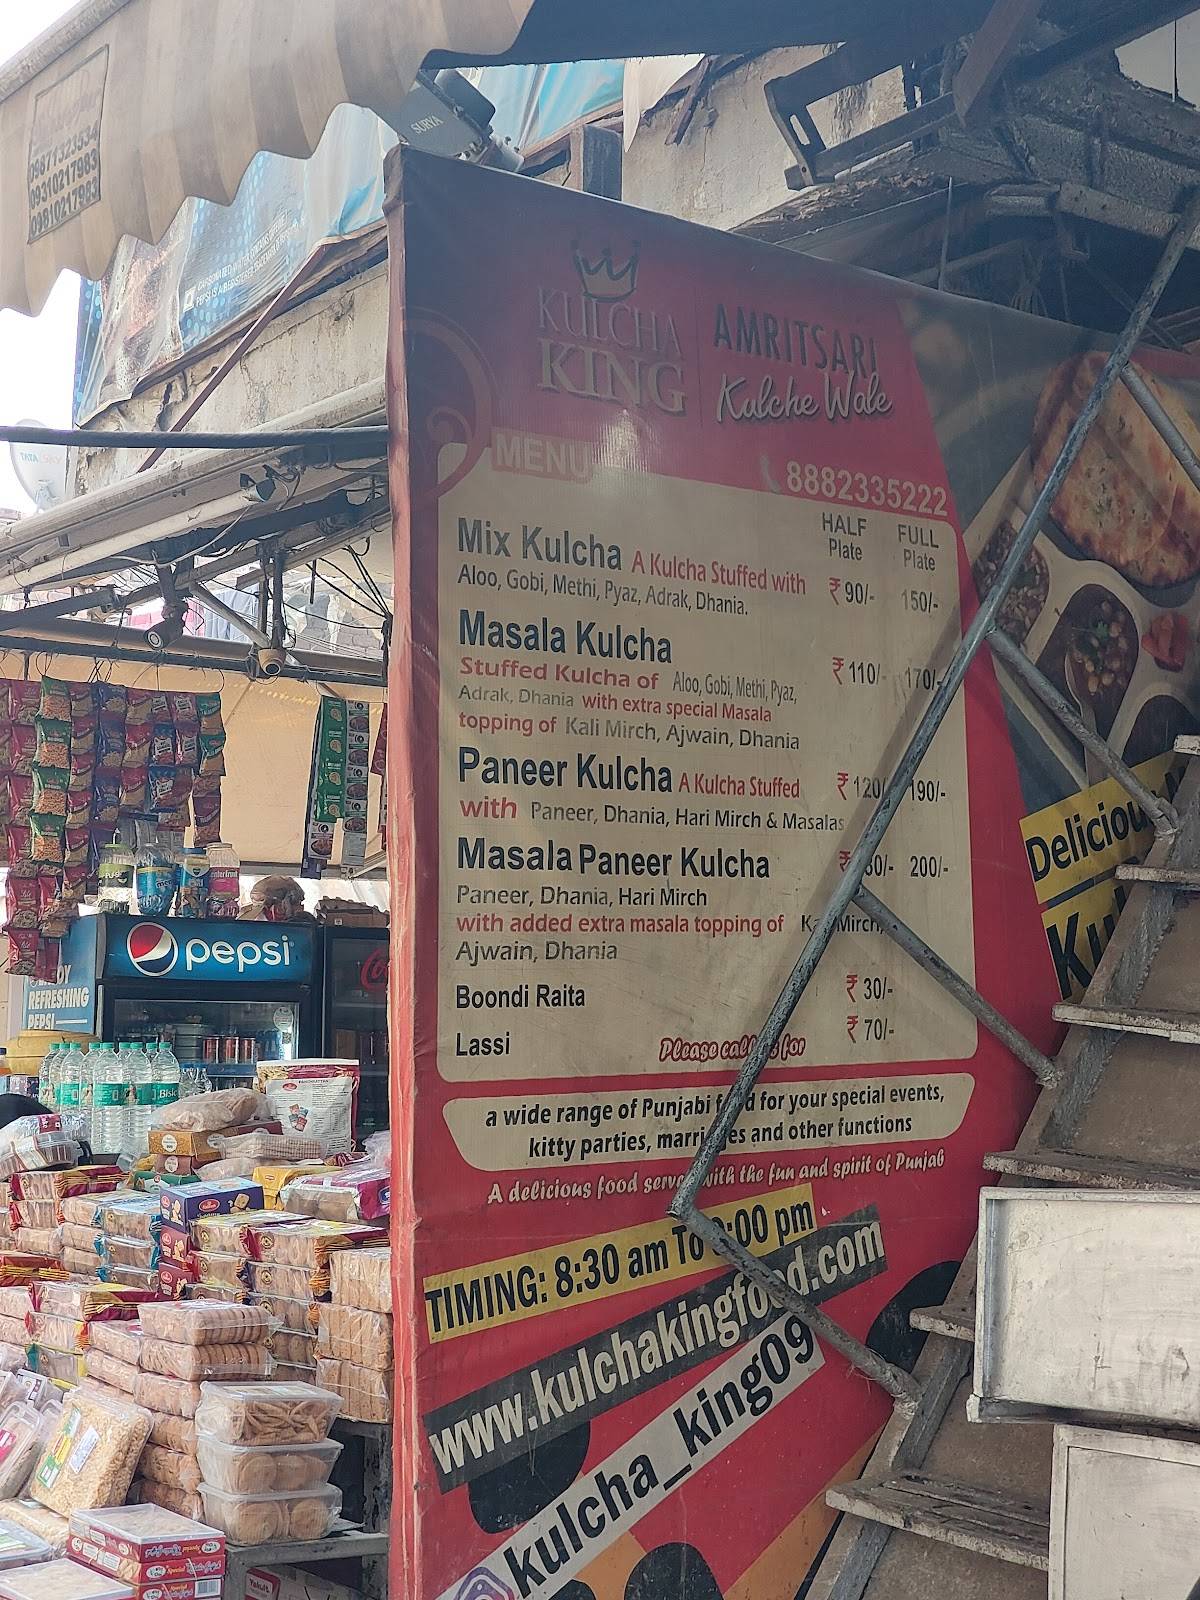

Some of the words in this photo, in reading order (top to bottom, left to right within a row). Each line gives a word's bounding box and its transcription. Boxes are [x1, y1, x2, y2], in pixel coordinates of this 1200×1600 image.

[411, 115, 444, 135] SURYA
[30, 148, 98, 210] 09310217983
[31, 176, 98, 237] 09810217983
[538, 287, 682, 358] KULCHA
[713, 303, 878, 379] AMRITSARI
[537, 338, 687, 417] KING
[716, 373, 820, 423] Kulche
[824, 370, 893, 420] Wale
[495, 433, 590, 478] MENU
[787, 461, 948, 516] 8882335222
[822, 512, 867, 537] HALF
[898, 524, 939, 549] FULL
[458, 517, 512, 557] Mix
[522, 525, 622, 571] Kulcha
[631, 550, 645, 574] A
[650, 554, 706, 582] Kulcha
[711, 560, 768, 591] Stuffed
[772, 574, 806, 595] with
[828, 538, 863, 561] Plate
[903, 548, 936, 571] Plate
[458, 564, 501, 591] Aloo,
[506, 569, 548, 595] Gobi,
[553, 573, 600, 600] Methi,
[605, 580, 641, 606] Pyaz,
[646, 585, 692, 611] Adrak,
[696, 590, 748, 616] Dhania.
[902, 588, 939, 614] 150/-
[459, 609, 566, 653] Masala
[576, 620, 672, 664] Kulcha
[460, 657, 548, 680] Stuffed
[555, 664, 630, 688] Kulcha
[637, 672, 660, 690] of
[672, 671, 702, 697] Aloo,
[704, 673, 733, 699] Gobi,
[735, 676, 768, 702] Methi,
[770, 682, 798, 706] Pyaz,
[458, 685, 513, 704] Adrak,
[518, 688, 574, 707] Dhania
[582, 692, 618, 711] with
[622, 696, 661, 714] extra
[666, 700, 718, 723] special
[722, 705, 772, 723] Masala
[458, 712, 534, 736] topping
[539, 716, 557, 733] of
[565, 717, 600, 737] Kali
[605, 719, 661, 744] Mirch,
[666, 725, 735, 748] Ajwain,
[739, 729, 800, 750] Dhania
[459, 746, 568, 787] Paneer
[577, 753, 672, 793] Kulcha
[679, 772, 690, 793] A
[695, 773, 746, 797] Kulcha
[749, 776, 800, 798] Stuffed
[909, 779, 946, 802] 190/-
[460, 796, 518, 819] with
[531, 801, 598, 825] Paneer,
[604, 804, 670, 828] Dhania,
[676, 808, 710, 826] Hari
[715, 809, 761, 828] Mirch
[766, 812, 778, 828] &
[782, 812, 844, 831] Masalas
[458, 837, 572, 871] Masala
[579, 844, 672, 876] Paneer
[681, 847, 770, 878] Kulcha
[1025, 801, 1153, 882] Deliciou
[910, 855, 949, 878] 200/-
[457, 885, 534, 907] Paneer,
[541, 886, 613, 908] Dhania,
[619, 888, 655, 906] Hari
[660, 888, 707, 906] Mirch
[456, 913, 504, 933] with
[510, 914, 572, 933] added
[578, 916, 625, 933] extra
[630, 914, 689, 933] masala
[694, 915, 762, 937] topping
[768, 914, 784, 933] of
[186, 935, 290, 972] pepsi
[455, 941, 538, 966] Ajwain,
[545, 940, 618, 960] Dhania
[28, 986, 90, 1010] REFRESHING
[457, 984, 529, 1008] Boondi
[537, 984, 585, 1007] Raita
[28, 1013, 55, 1030] PEPSI
[456, 1032, 510, 1056] Lassi
[659, 1037, 719, 1063] Please
[781, 1033, 806, 1061] for
[485, 1110, 497, 1127] a
[503, 1104, 551, 1125] wide
[557, 1102, 613, 1127] range
[618, 1098, 638, 1120] of
[642, 1095, 711, 1122] Punjabi
[716, 1092, 756, 1113] fd
[760, 1091, 784, 1111] for
[788, 1094, 828, 1115] your
[832, 1085, 885, 1111] special
[889, 1084, 944, 1103] events,
[529, 1137, 574, 1161] kitty
[580, 1131, 652, 1160] parties,
[657, 1127, 746, 1151] marries
[751, 1125, 784, 1143] and
[788, 1121, 834, 1140] other
[838, 1116, 912, 1137] functions
[487, 1183, 504, 1204] A
[509, 1179, 592, 1203] delicious
[597, 1172, 639, 1199] food
[739, 1163, 765, 1184] the
[768, 1162, 796, 1186] fun
[799, 1158, 829, 1179] and
[832, 1152, 872, 1180] spirit
[876, 1154, 892, 1174] of
[895, 1149, 945, 1172] Punjab
[425, 1270, 549, 1333] TIMING:
[554, 1242, 620, 1298] 8:30
[628, 1238, 669, 1278] am
[672, 1225, 704, 1265] To
[775, 1200, 815, 1246] pm
[503, 1315, 814, 1598] kulcha_king09
[249, 1578, 270, 1593] Yakult
